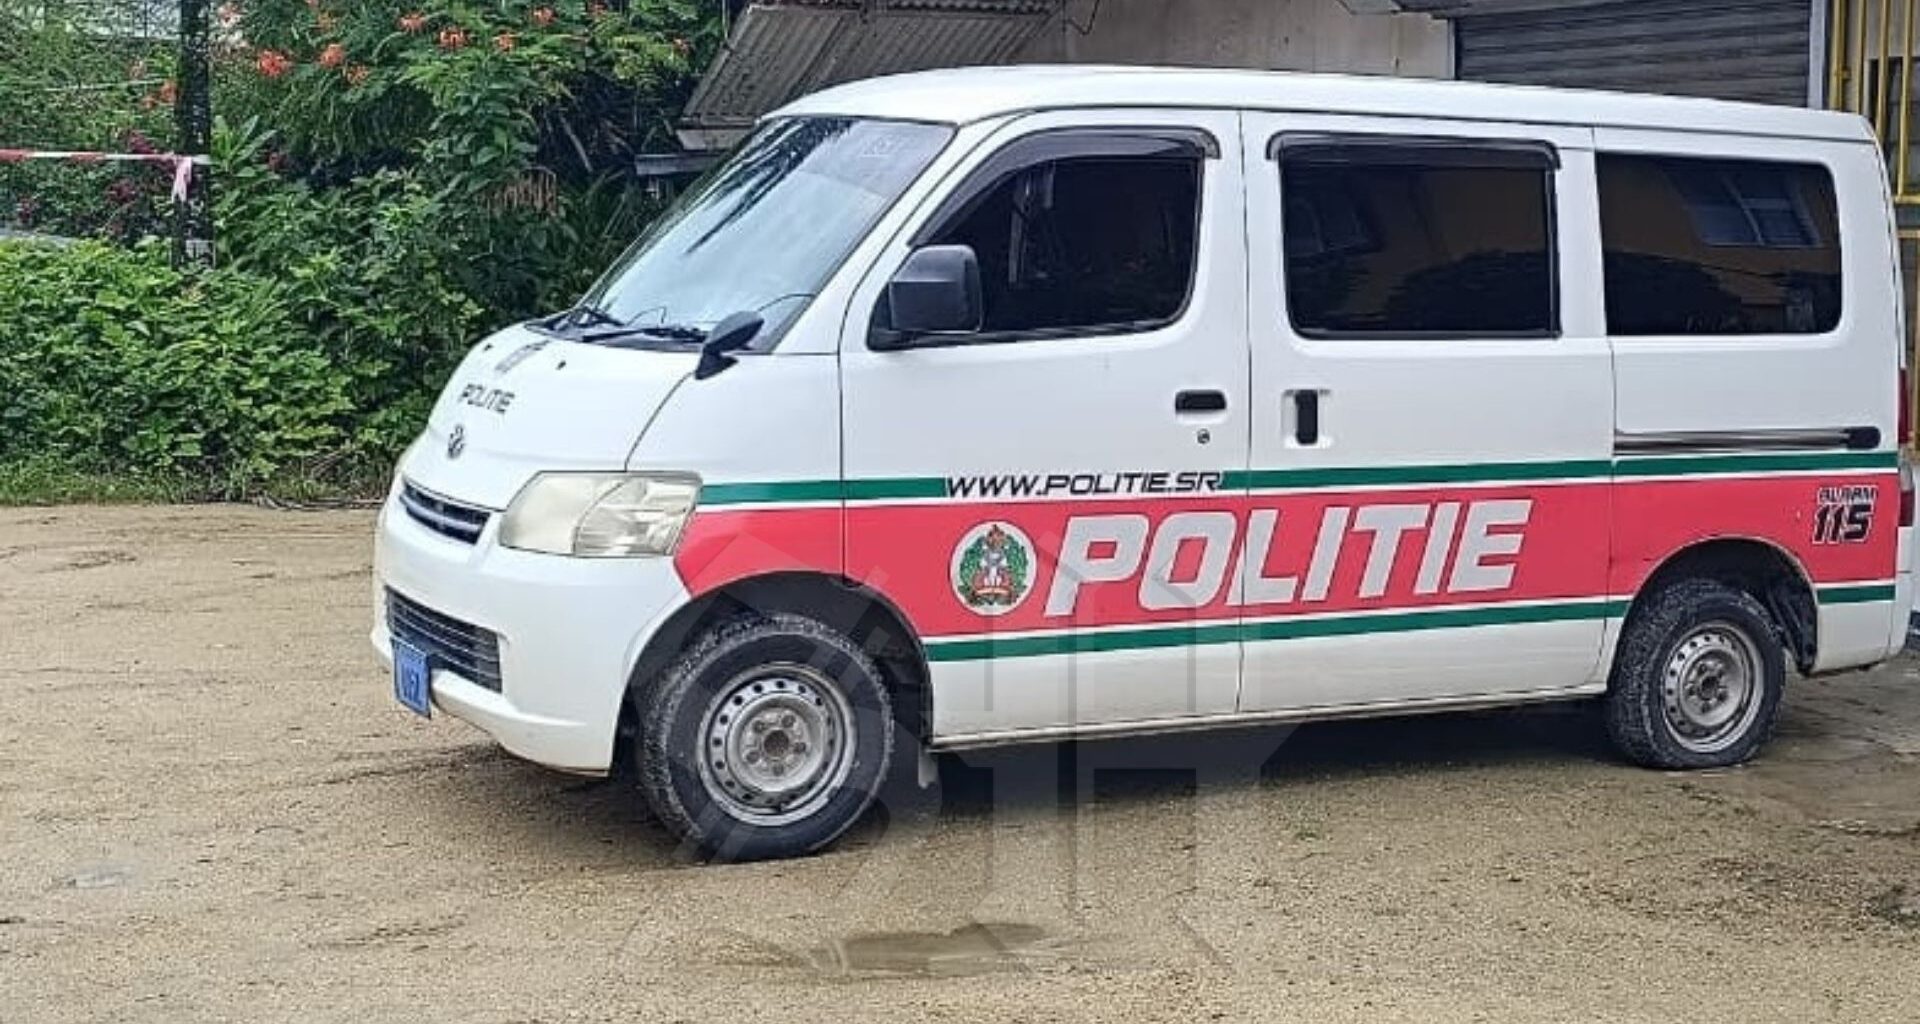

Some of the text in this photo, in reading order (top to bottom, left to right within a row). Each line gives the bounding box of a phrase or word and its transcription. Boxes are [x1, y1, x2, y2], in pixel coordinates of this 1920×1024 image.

[947, 472, 1220, 497] WWW.POLITIE.SR
[1812, 503, 1874, 544] 115
[1044, 499, 1533, 618] POLITIE
